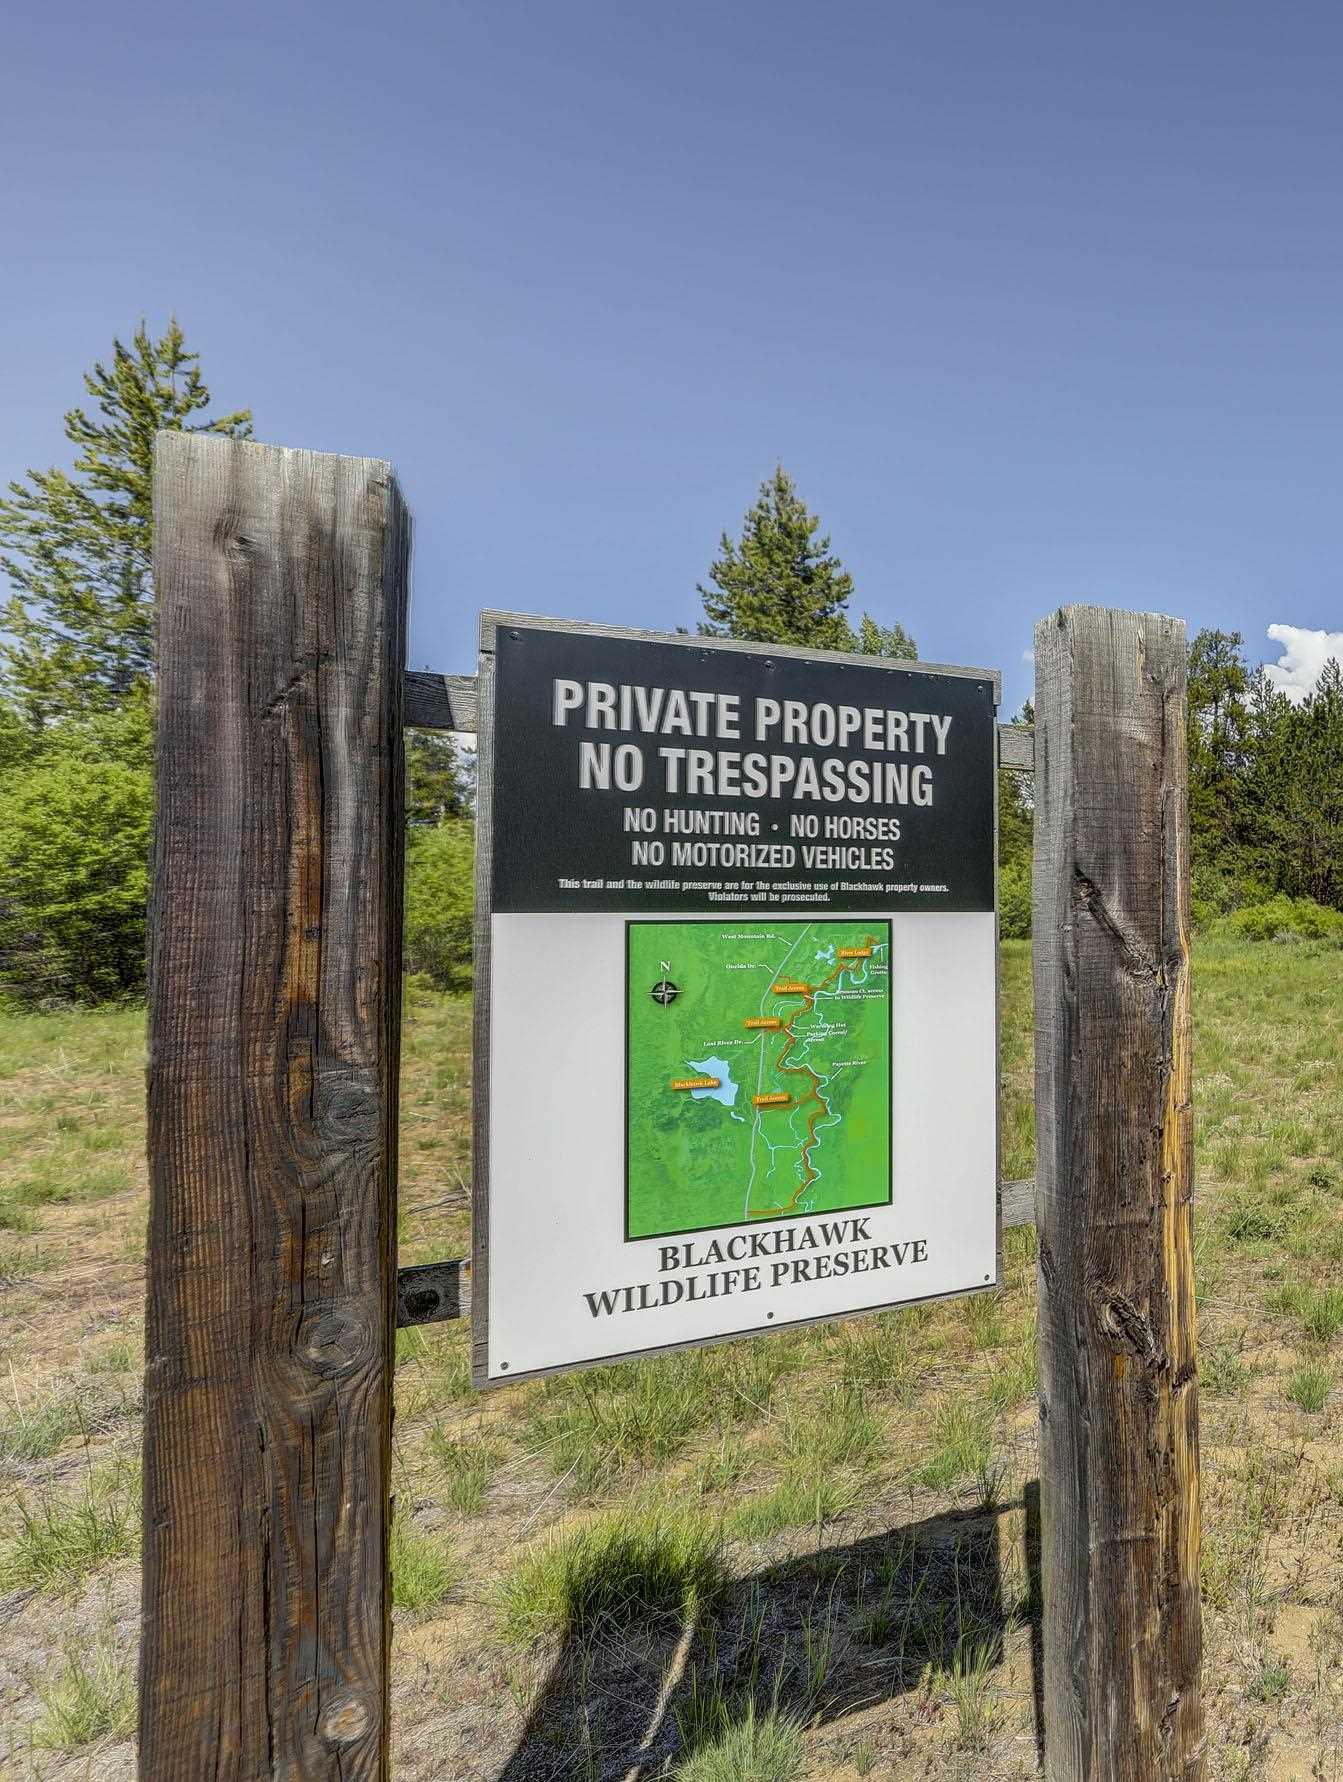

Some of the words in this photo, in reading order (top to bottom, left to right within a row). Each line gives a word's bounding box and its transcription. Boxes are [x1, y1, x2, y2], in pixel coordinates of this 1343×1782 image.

[553, 678, 740, 739] PRIVATE
[755, 698, 952, 755] PROPERTY
[578, 742, 643, 791] NO
[659, 747, 933, 806] TRESPASSING
[623, 807, 657, 832] NO
[663, 809, 759, 836] HUNTING
[790, 814, 819, 838] NO
[824, 816, 900, 841] HORSES
[631, 841, 664, 866] NO
[671, 842, 796, 868] MOTORIZED
[801, 846, 894, 870] VEHICLES
[558, 879, 580, 889] This
[582, 879, 603, 889] trail
[606, 880, 624, 889] and
[627, 880, 642, 889] the
[645, 880, 681, 889] wildlife
[682, 881, 722, 891] preserve
[725, 882, 739, 890] are
[741, 881, 754, 890] for
[756, 881, 770, 890] the
[772, 881, 812, 890] exclusive
[830, 882, 839, 890] of
[840, 882, 883, 891] Blackhawk
[886, 883, 918, 893] property
[919, 884, 949, 892] owners.
[708, 892, 749, 901] Violators
[751, 892, 766, 901] will
[769, 892, 780, 901] be
[781, 893, 831, 903] prosecuted.
[660, 960, 671, 972] N
[659, 1217, 872, 1272] BLACKHAWK
[582, 1266, 762, 1319] WILDLIFE
[770, 1239, 929, 1287] PRESERVE
